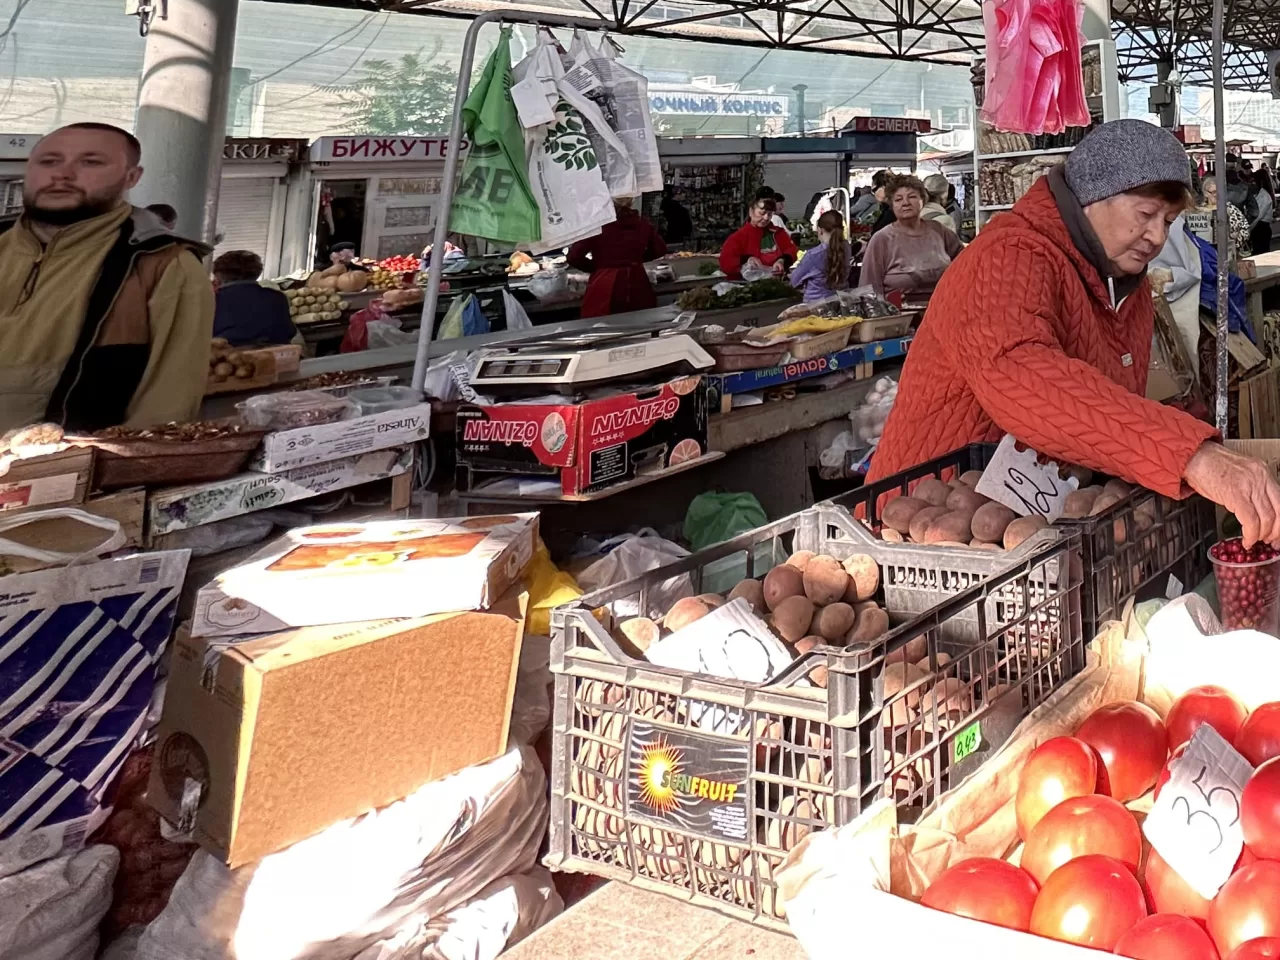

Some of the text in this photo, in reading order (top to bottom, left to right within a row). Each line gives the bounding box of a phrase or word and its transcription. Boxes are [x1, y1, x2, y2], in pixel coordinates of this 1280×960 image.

[723, 100, 783, 114] КОРПУС
[867, 117, 919, 132] СЕМЕНА
[9, 138, 26, 147] 42
[755, 357, 827, 381] daviel natural
[377, 416, 420, 433] Alnesta
[591, 396, 680, 436] ÖZİNAN
[463, 420, 539, 447] ÖZİNAN
[1004, 467, 1060, 518] 12
[1171, 765, 1240, 855] 35
